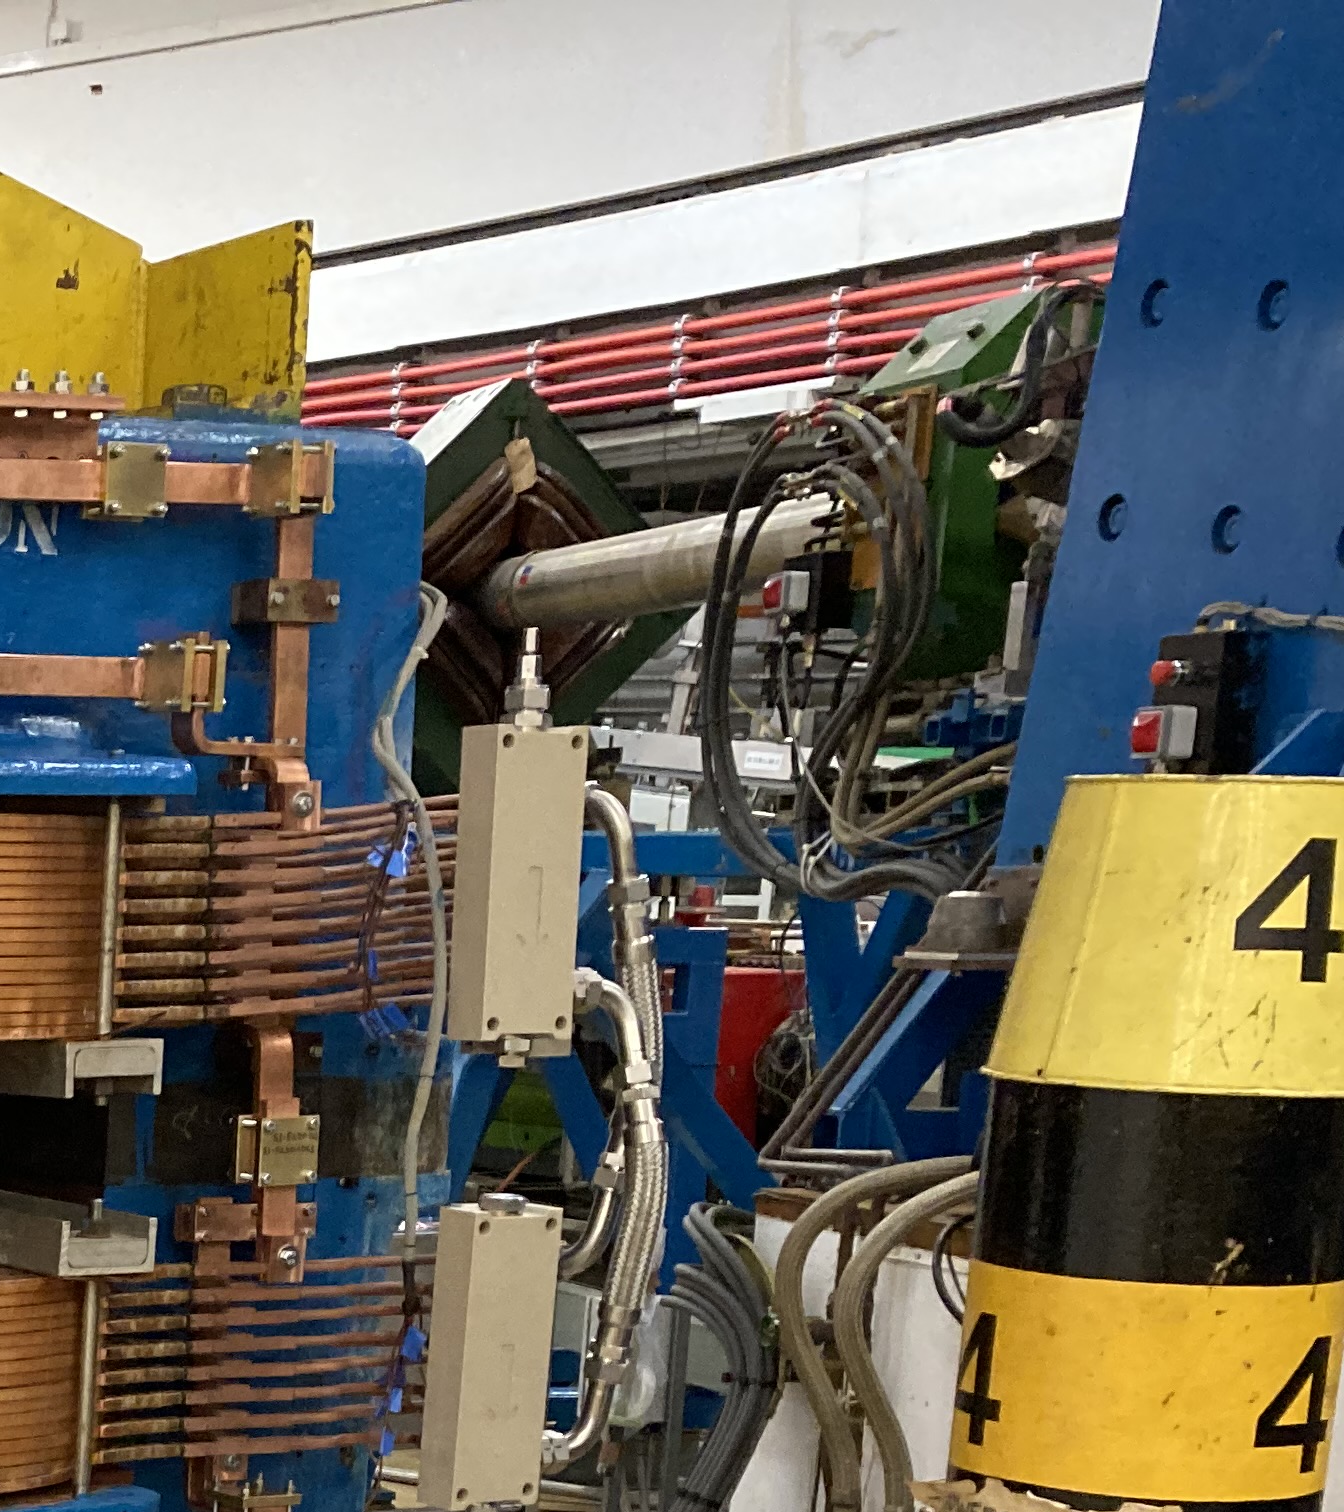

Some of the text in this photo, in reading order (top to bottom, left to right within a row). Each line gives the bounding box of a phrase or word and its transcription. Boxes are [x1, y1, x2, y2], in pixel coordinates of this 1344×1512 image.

[1234, 837, 1344, 982] 4
[955, 1312, 1332, 1473] 4 4
